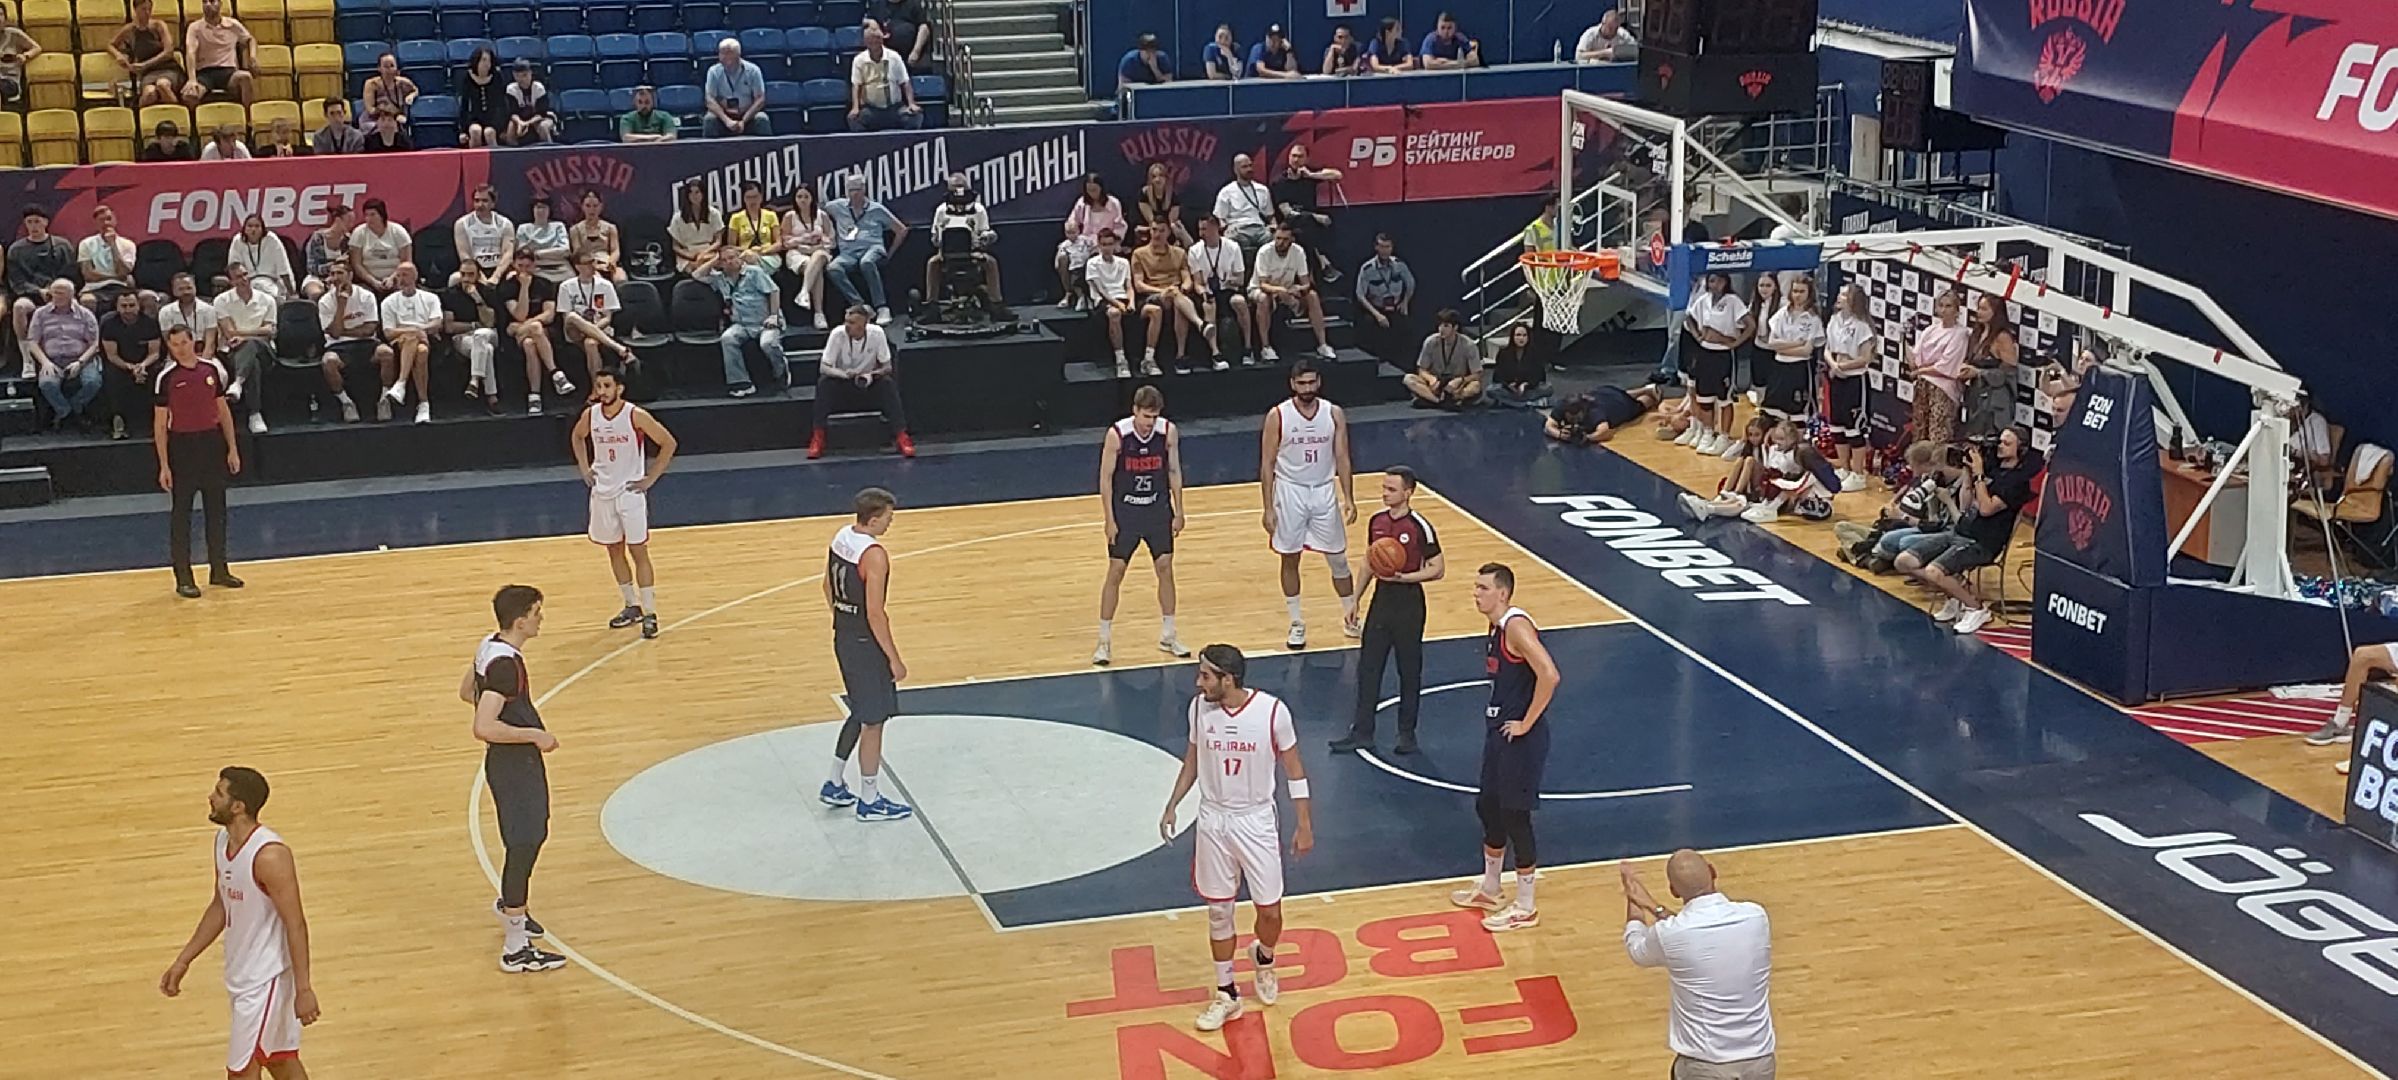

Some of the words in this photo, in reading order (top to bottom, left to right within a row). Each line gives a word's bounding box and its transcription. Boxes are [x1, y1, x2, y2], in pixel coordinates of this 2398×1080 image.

[1120, 127, 1218, 166] RUSSIA
[1405, 144, 1516, 165] БУКМЕКЕРОВ
[1406, 129, 1483, 150] РЕЙТИНГ
[525, 153, 636, 198] RUSSIA
[671, 142, 801, 213] ГАВНАЯ
[148, 183, 367, 234] FONBET
[2082, 410, 2109, 431] BET
[2087, 394, 2114, 415] FON
[1135, 475, 1153, 491] 25
[2055, 474, 2112, 523] RUSSIA
[1529, 494, 1812, 606] FONBET
[2047, 593, 2108, 634] FONBET
[1223, 757, 1242, 777] 17
